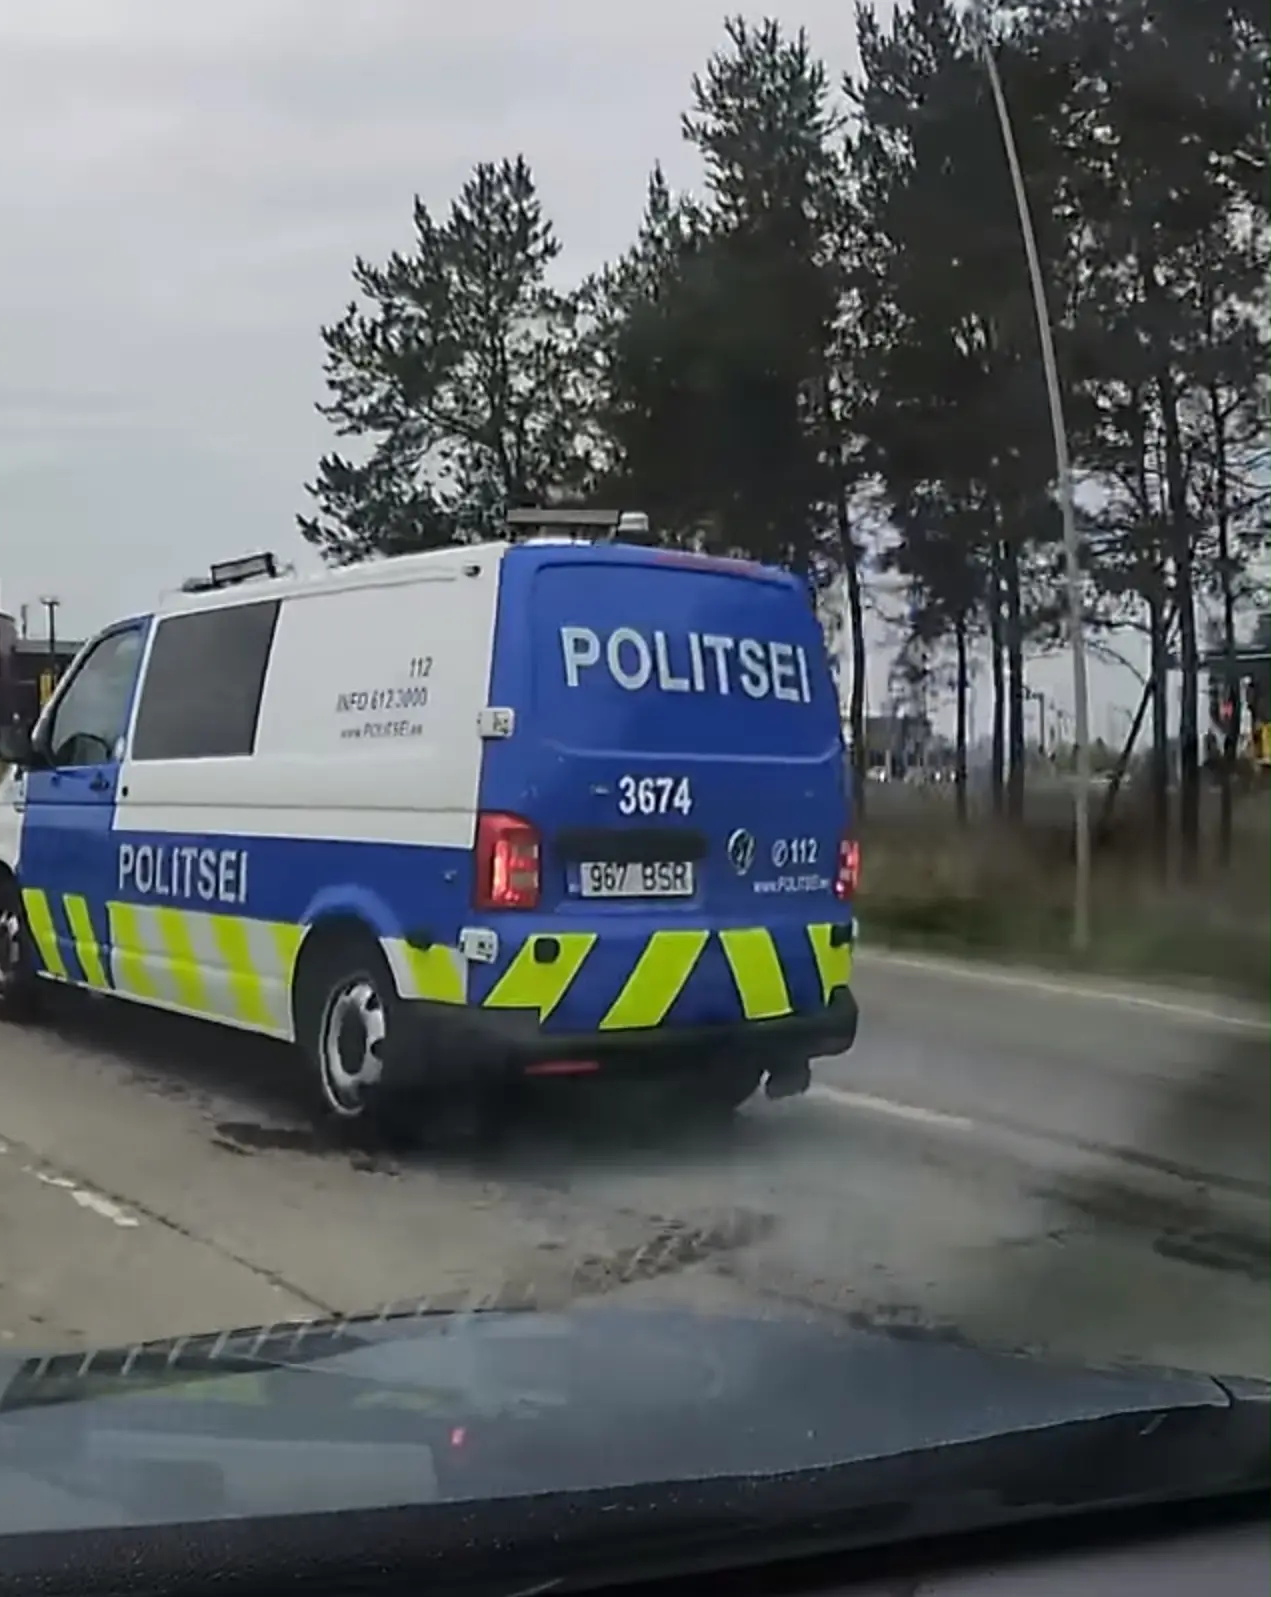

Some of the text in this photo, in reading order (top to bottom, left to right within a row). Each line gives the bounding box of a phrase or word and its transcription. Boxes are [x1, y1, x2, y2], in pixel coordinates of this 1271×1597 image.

[409, 656, 433, 678] 112
[559, 626, 812, 703] POLITSEI
[618, 776, 693, 816] 3674
[790, 837, 818, 864] 112
[119, 843, 249, 904] POLITSEI
[591, 863, 687, 892] 967 BSR
